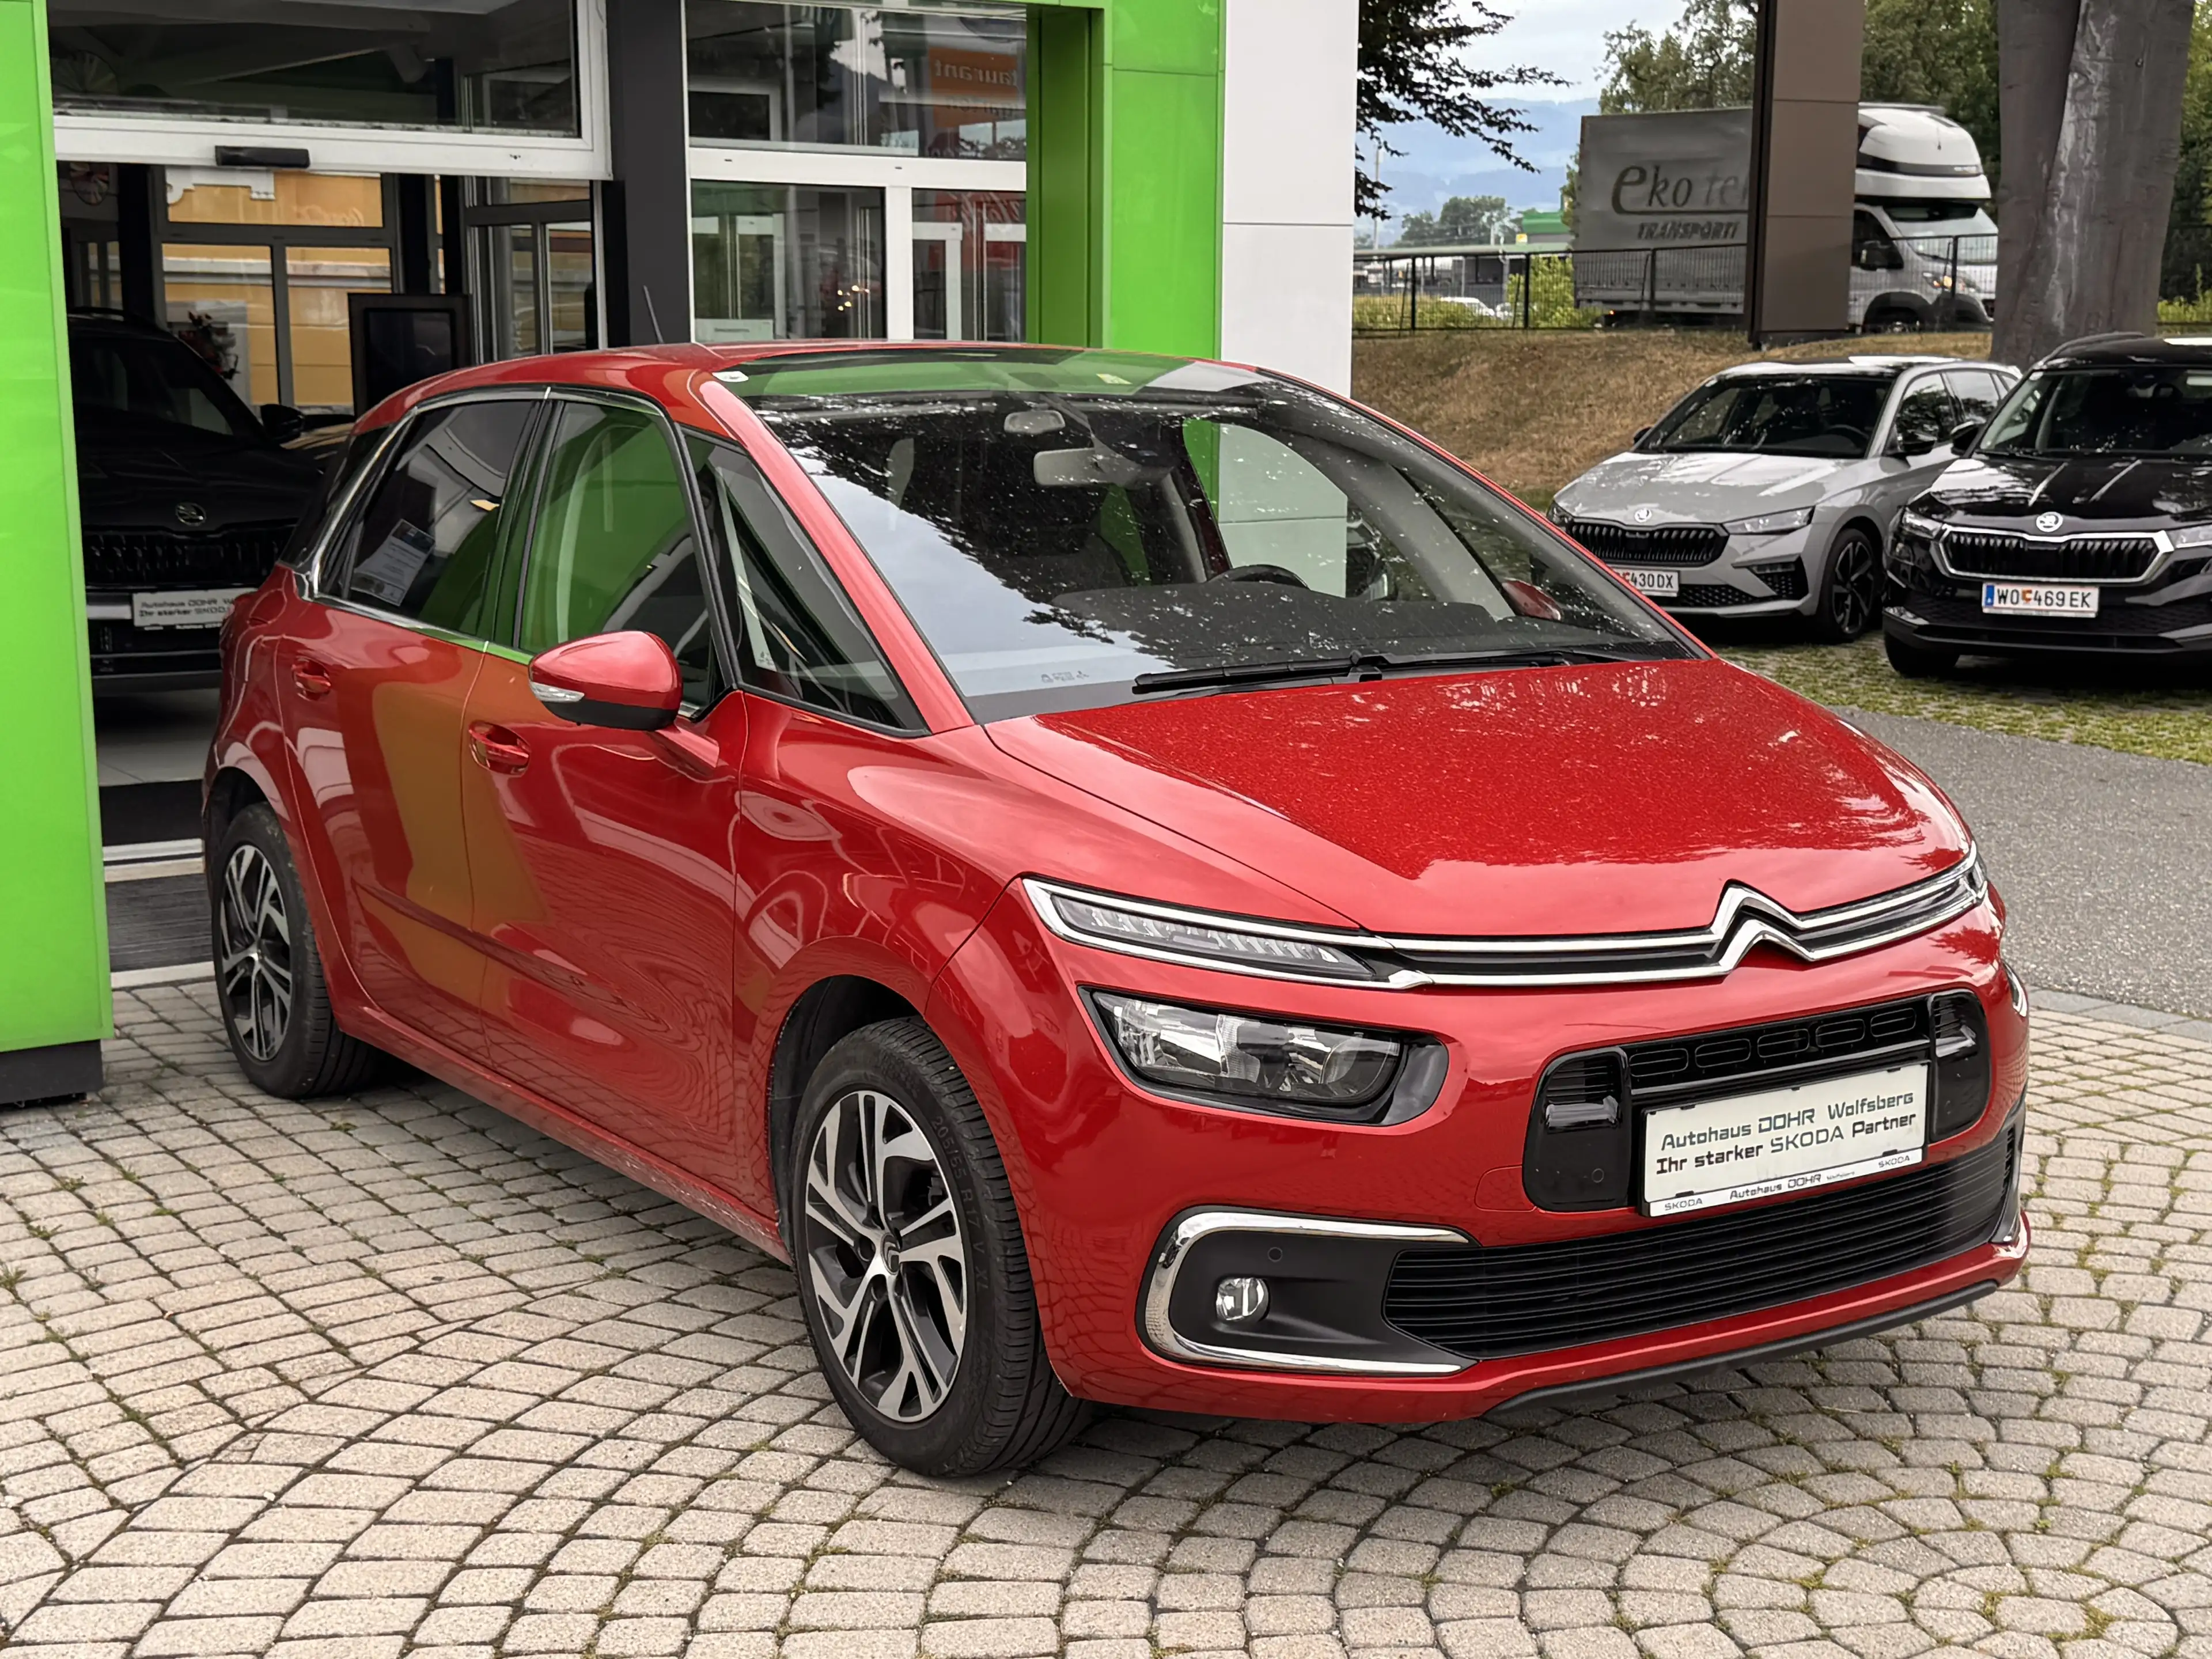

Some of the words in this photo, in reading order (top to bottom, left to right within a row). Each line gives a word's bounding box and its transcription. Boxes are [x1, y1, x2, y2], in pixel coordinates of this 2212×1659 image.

[1661, 1124, 1751, 1151] Autohaus
[1758, 1108, 1815, 1134] DOHR
[1656, 1157, 1687, 1175] Ihr
[1695, 1145, 1763, 1168] starker
[1771, 1126, 1844, 1153] SKODA
[1852, 1113, 1916, 1138] Partner
[1878, 1155, 1910, 1168] SKODA
[1729, 1184, 1782, 1200] Autohaus
[1664, 1198, 1703, 1211] SKODA
